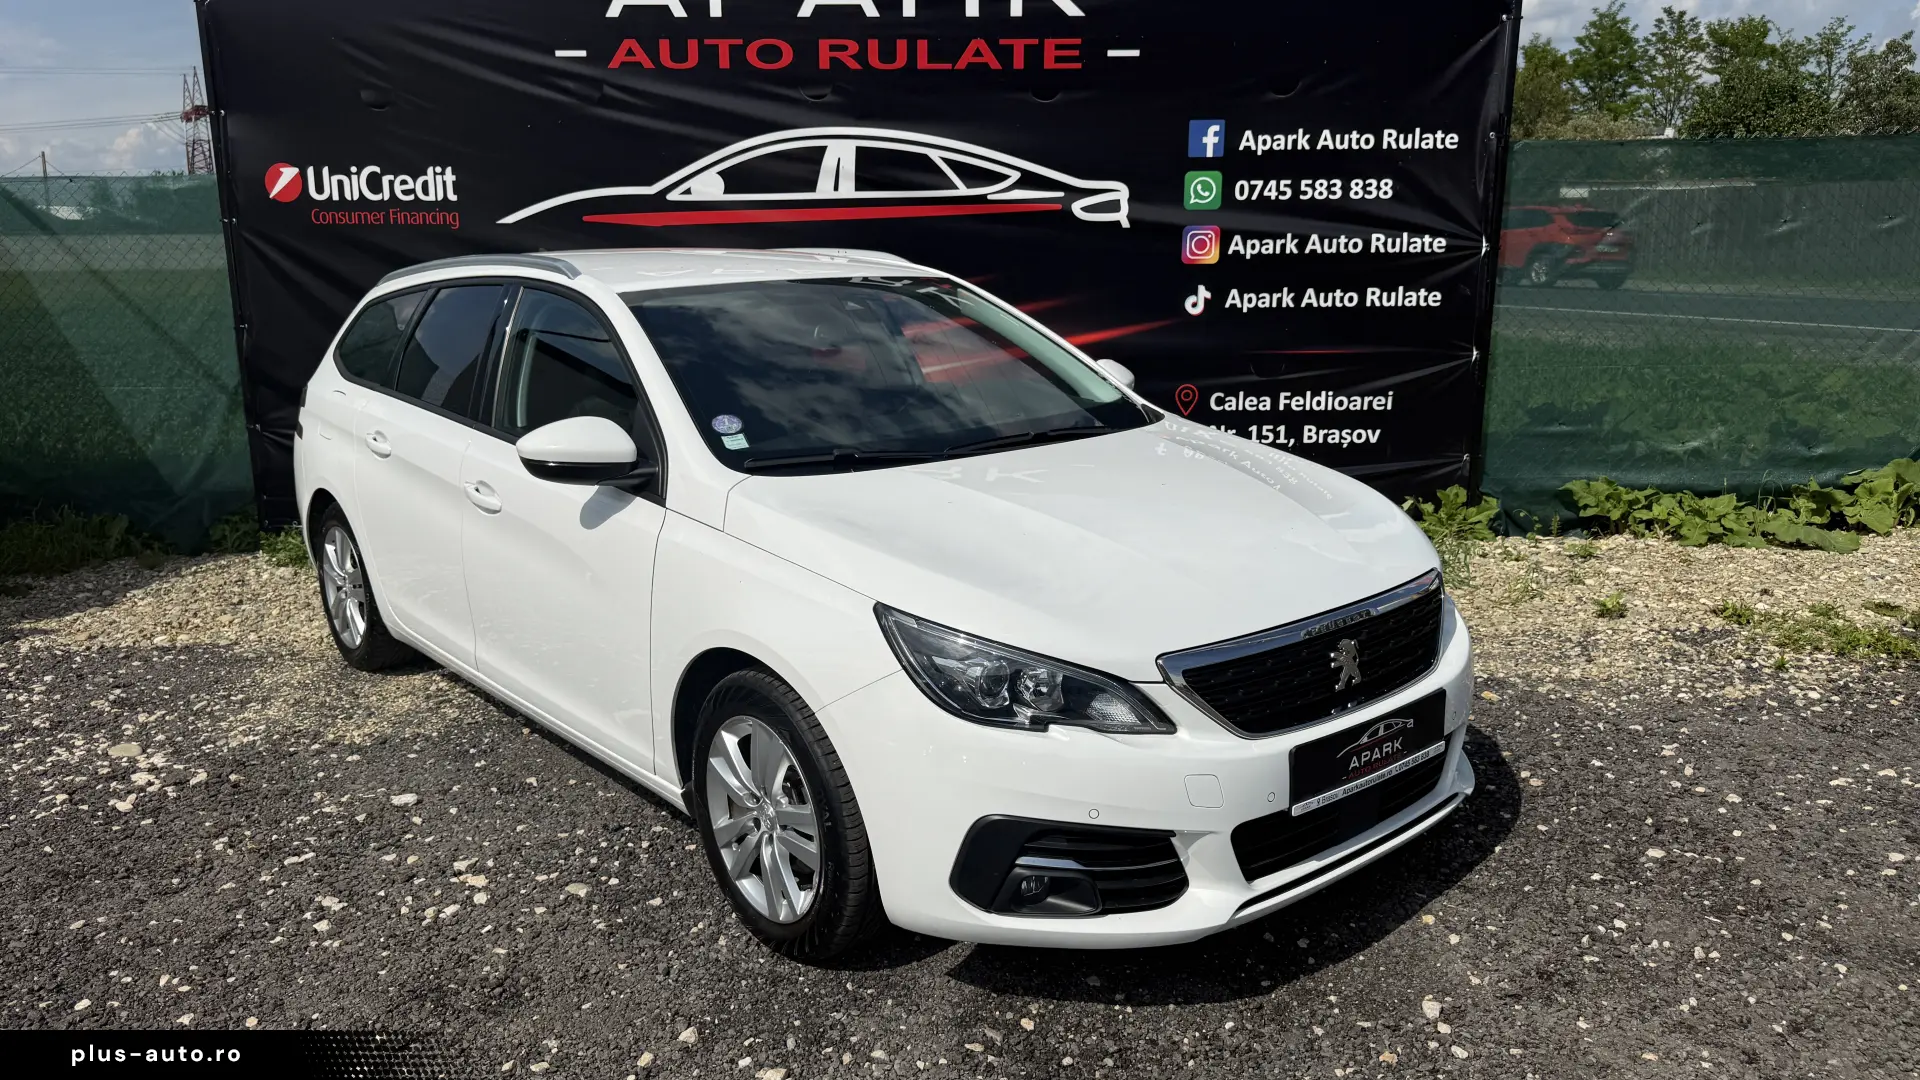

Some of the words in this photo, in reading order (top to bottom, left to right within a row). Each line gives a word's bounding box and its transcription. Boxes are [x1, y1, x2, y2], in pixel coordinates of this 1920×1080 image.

[607, 37, 795, 71] AUTO
[817, 37, 1084, 71] RULATE
[1238, 127, 1312, 156] Apark
[1316, 128, 1376, 151] Auto
[1382, 127, 1460, 150] Rulate
[306, 165, 458, 202] UniCredit
[1234, 179, 1293, 201] 0745
[1299, 178, 1343, 200] 583
[1349, 178, 1394, 200] 838
[311, 208, 385, 225] Consumer
[389, 208, 460, 230] Financing
[1227, 232, 1299, 260] Apark
[1304, 233, 1364, 254] Auto
[1370, 231, 1448, 254] Rulate
[1224, 286, 1296, 313] Apark
[1300, 287, 1360, 308] Auto
[1365, 285, 1443, 307] Rulate
[1209, 390, 1272, 412] Calea
[1278, 390, 1395, 412] Feldioarei
[1248, 424, 1296, 448] 151,
[1302, 424, 1382, 449] Brașov
[1348, 736, 1403, 771] APARK
